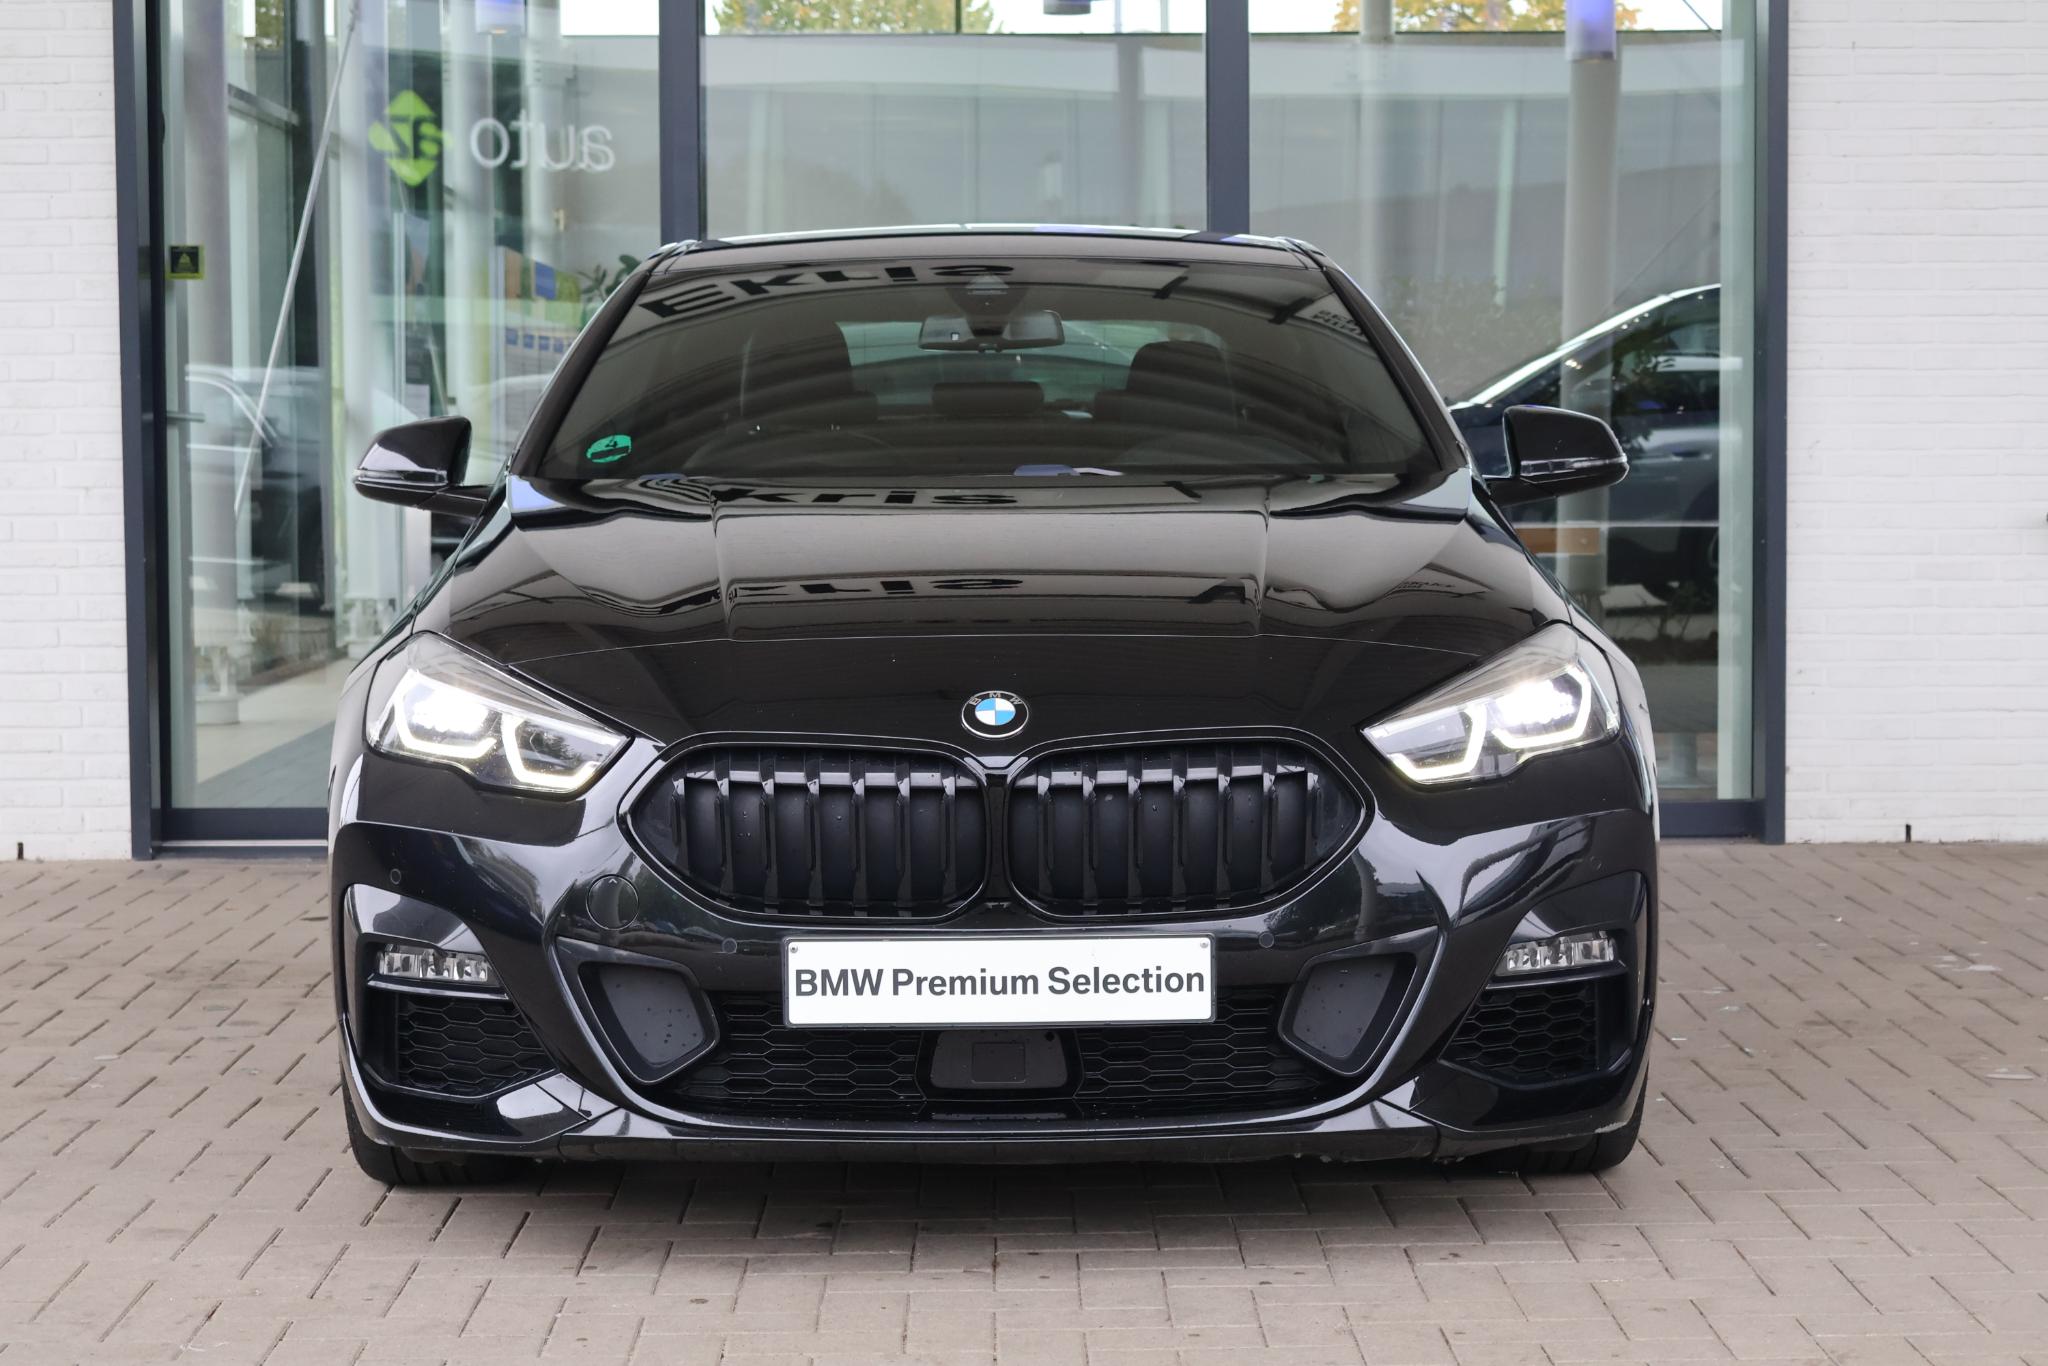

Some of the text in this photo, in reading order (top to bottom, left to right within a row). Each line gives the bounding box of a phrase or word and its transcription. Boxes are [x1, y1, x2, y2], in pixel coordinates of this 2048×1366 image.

[968, 692, 1023, 706] BMW
[795, 966, 1205, 996] BMW Premium Selection
